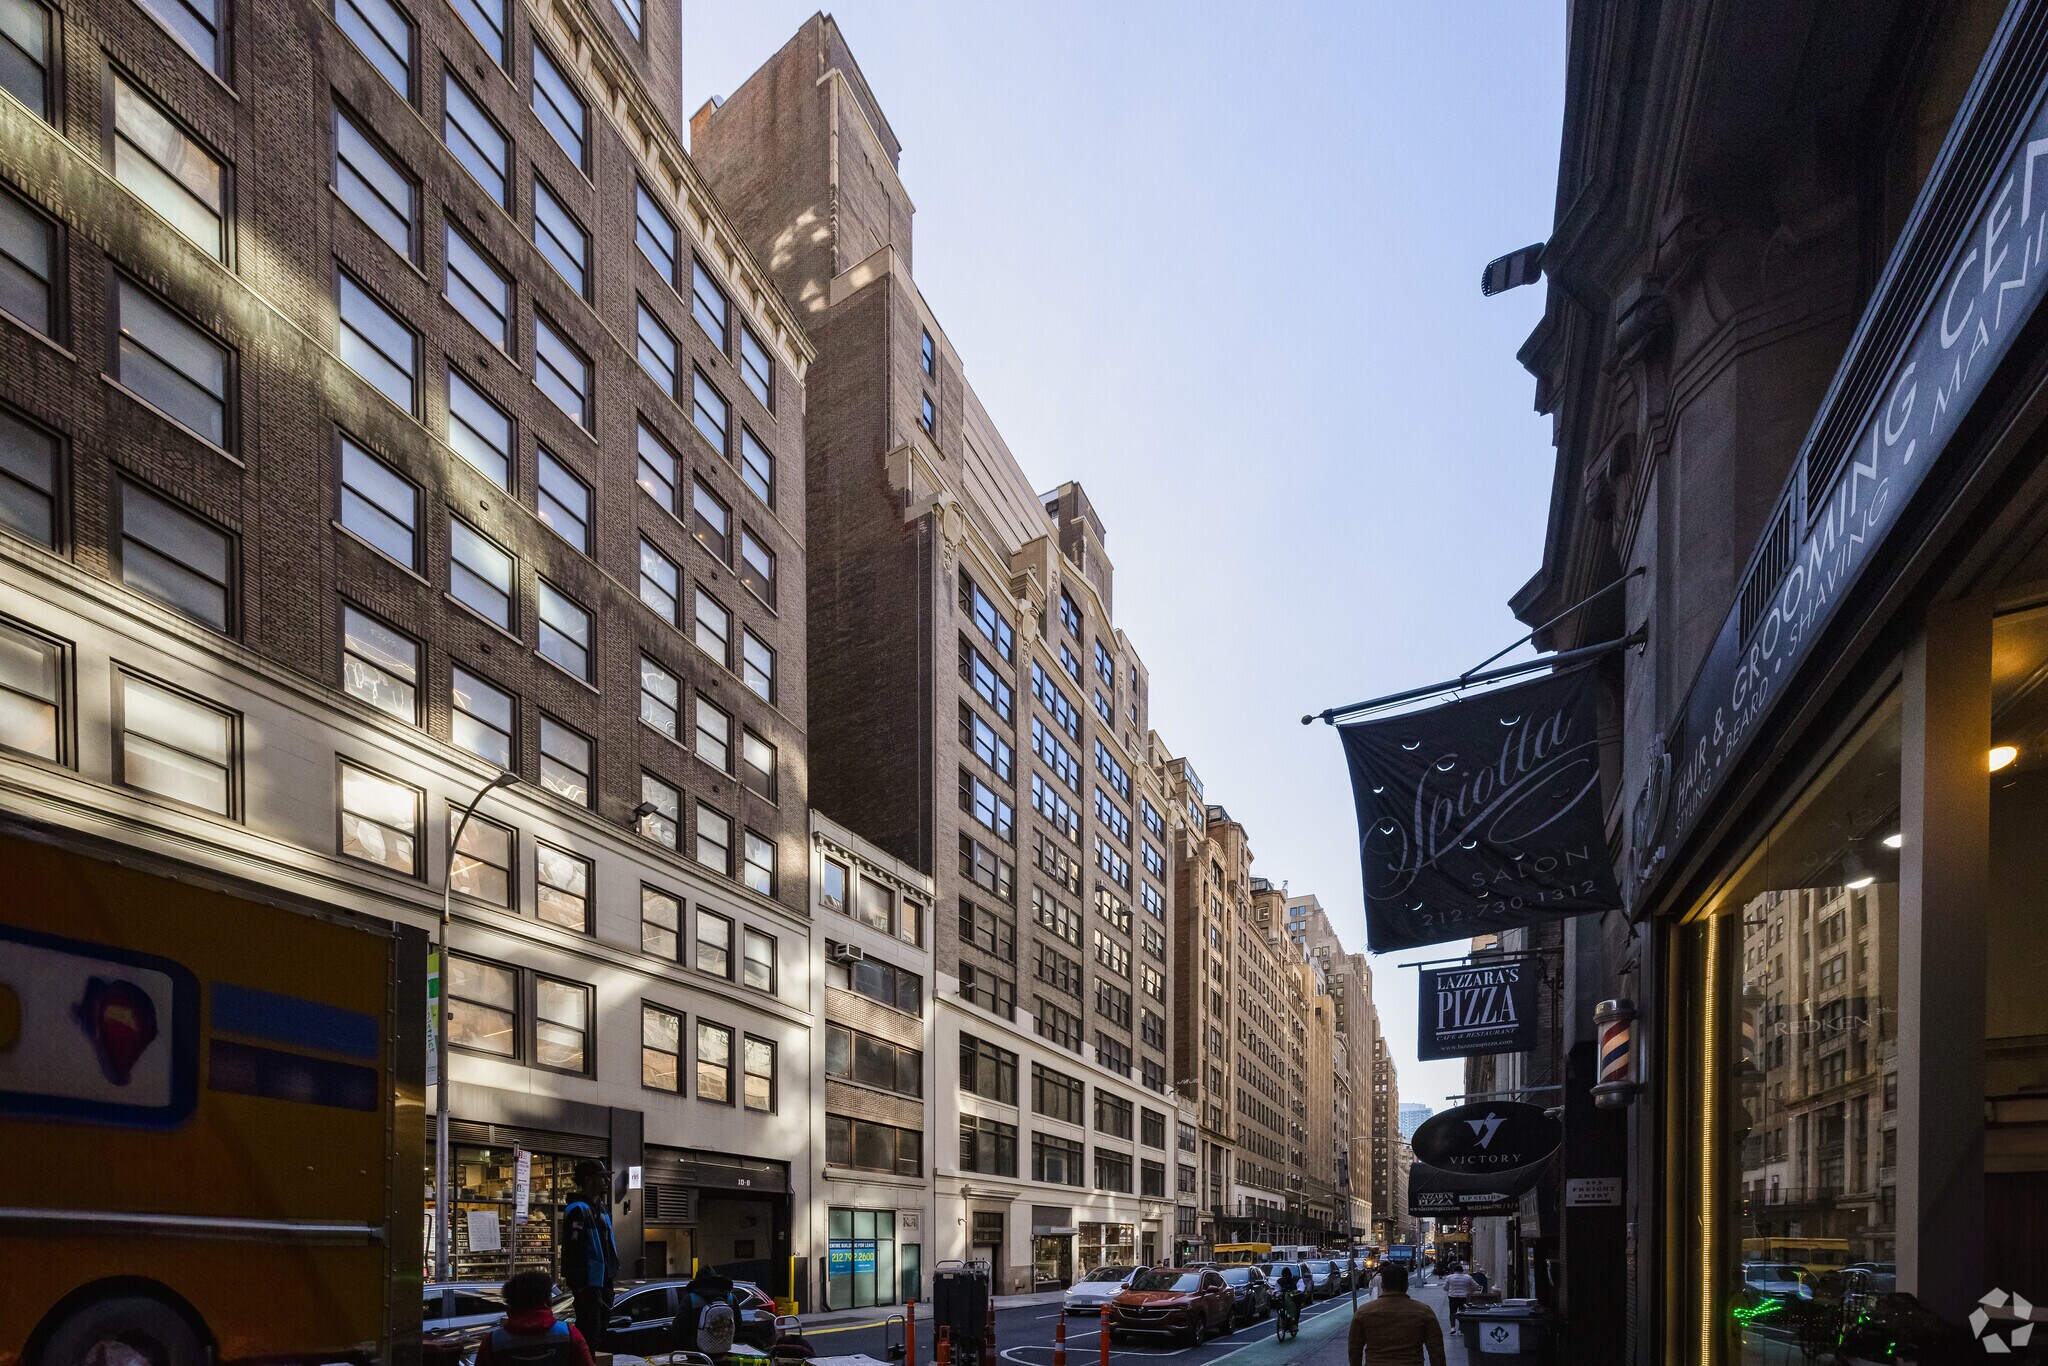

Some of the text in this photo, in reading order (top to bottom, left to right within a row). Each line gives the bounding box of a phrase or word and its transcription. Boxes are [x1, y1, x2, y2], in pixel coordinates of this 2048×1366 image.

[1677, 735, 1707, 814] HAIR
[1713, 706, 1725, 746] &
[1732, 361, 1918, 711] GROOMING
[1675, 768, 1712, 839] STYLING
[1725, 676, 1770, 757] BEARD
[1788, 476, 1890, 660] SHAVING
[1361, 706, 1575, 901] Spiotta
[1472, 845, 1590, 888] SALON
[1422, 879, 1596, 927] 212.730.1312
[1437, 968, 1519, 990] LAZZARA'S
[1436, 984, 1518, 1030] PIZZA
[1774, 1014, 1872, 1036] REDKEN
[1436, 1034, 1456, 1042] CAFE
[1466, 1028, 1516, 1038] RESTAURANT
[1440, 1040, 1513, 1051] www.lazzaraspizza.com
[1450, 1153, 1521, 1165] VICTORY
